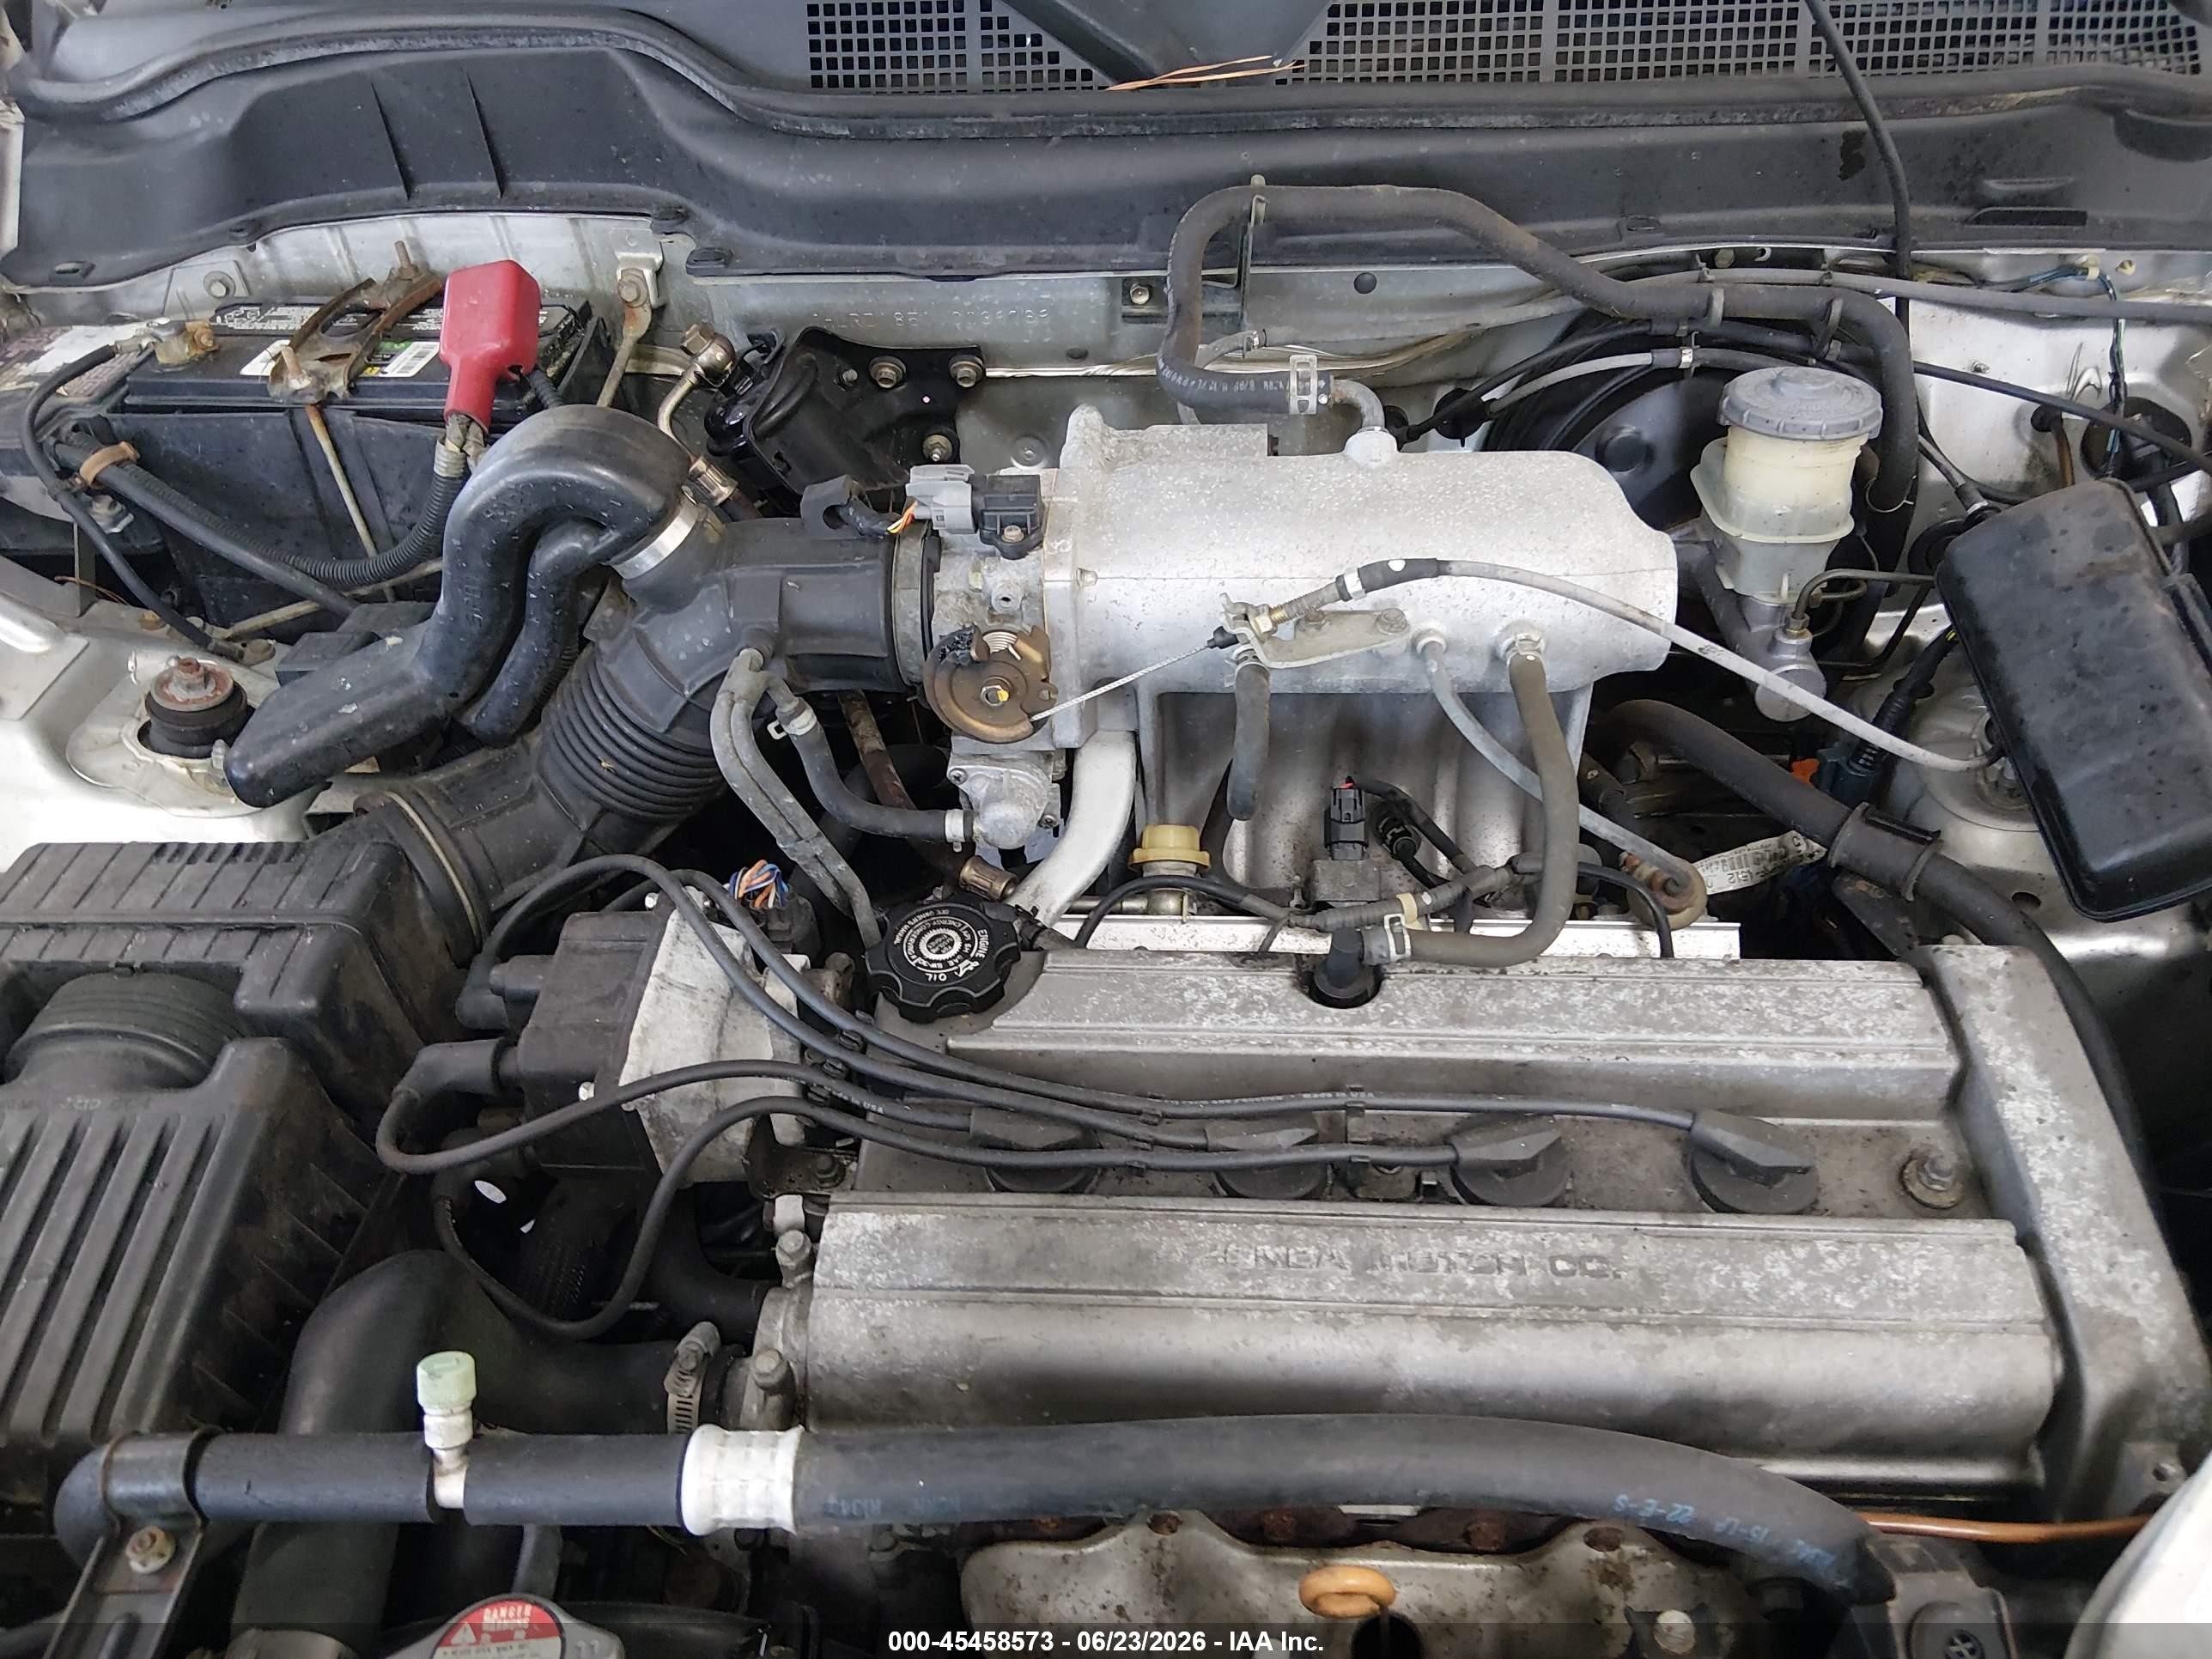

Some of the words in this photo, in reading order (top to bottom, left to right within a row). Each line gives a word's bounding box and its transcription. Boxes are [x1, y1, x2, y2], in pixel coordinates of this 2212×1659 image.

[975, 928, 990, 958] ENGINE
[925, 973, 947, 981] OIL
[863, 1101, 885, 1115] USA
